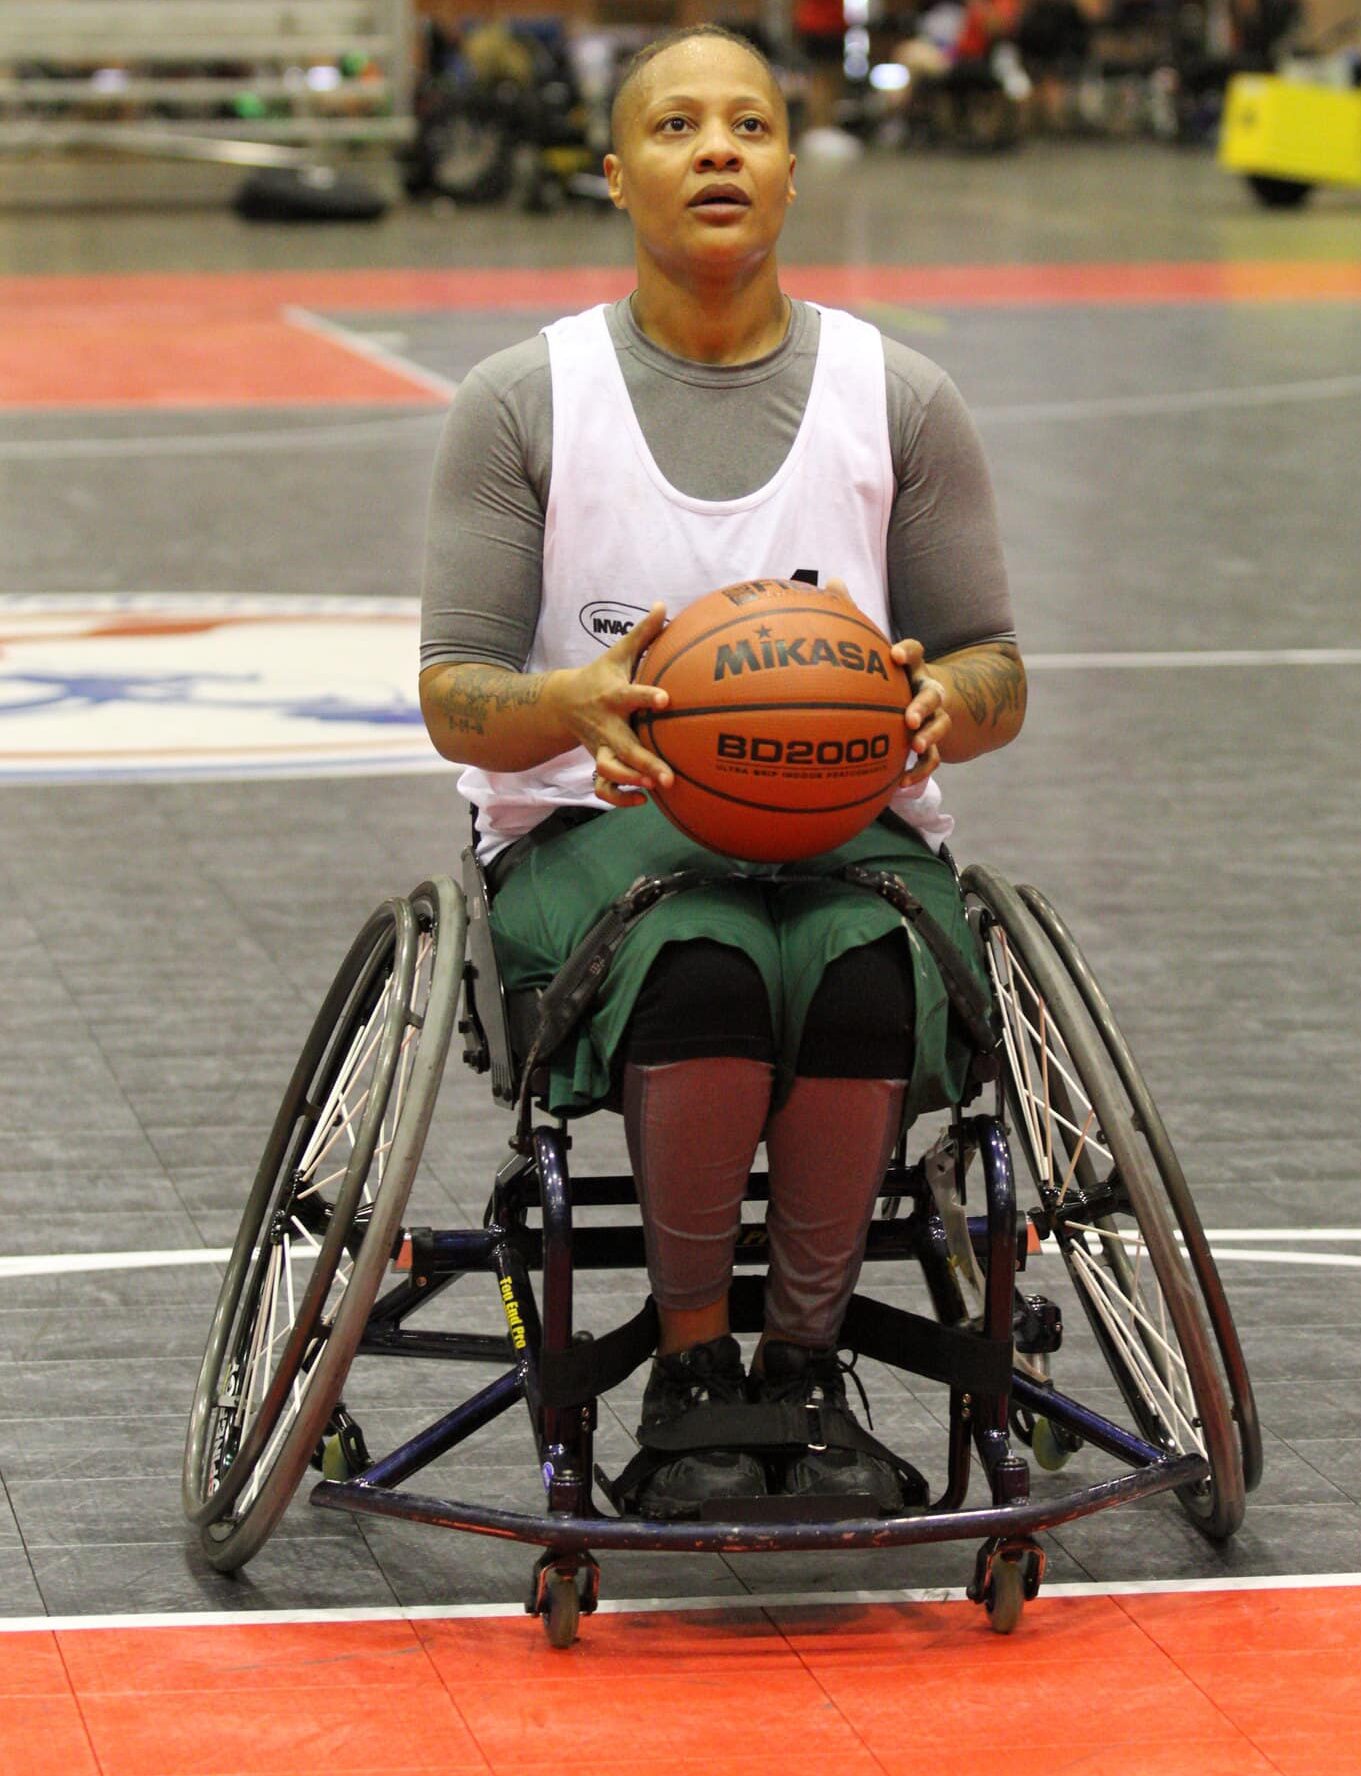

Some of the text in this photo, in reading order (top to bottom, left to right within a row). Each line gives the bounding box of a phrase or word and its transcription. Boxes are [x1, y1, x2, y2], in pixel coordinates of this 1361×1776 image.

[717, 733, 890, 765] BD2000
[505, 1302, 522, 1326] End
[513, 1326, 527, 1349] Pro
